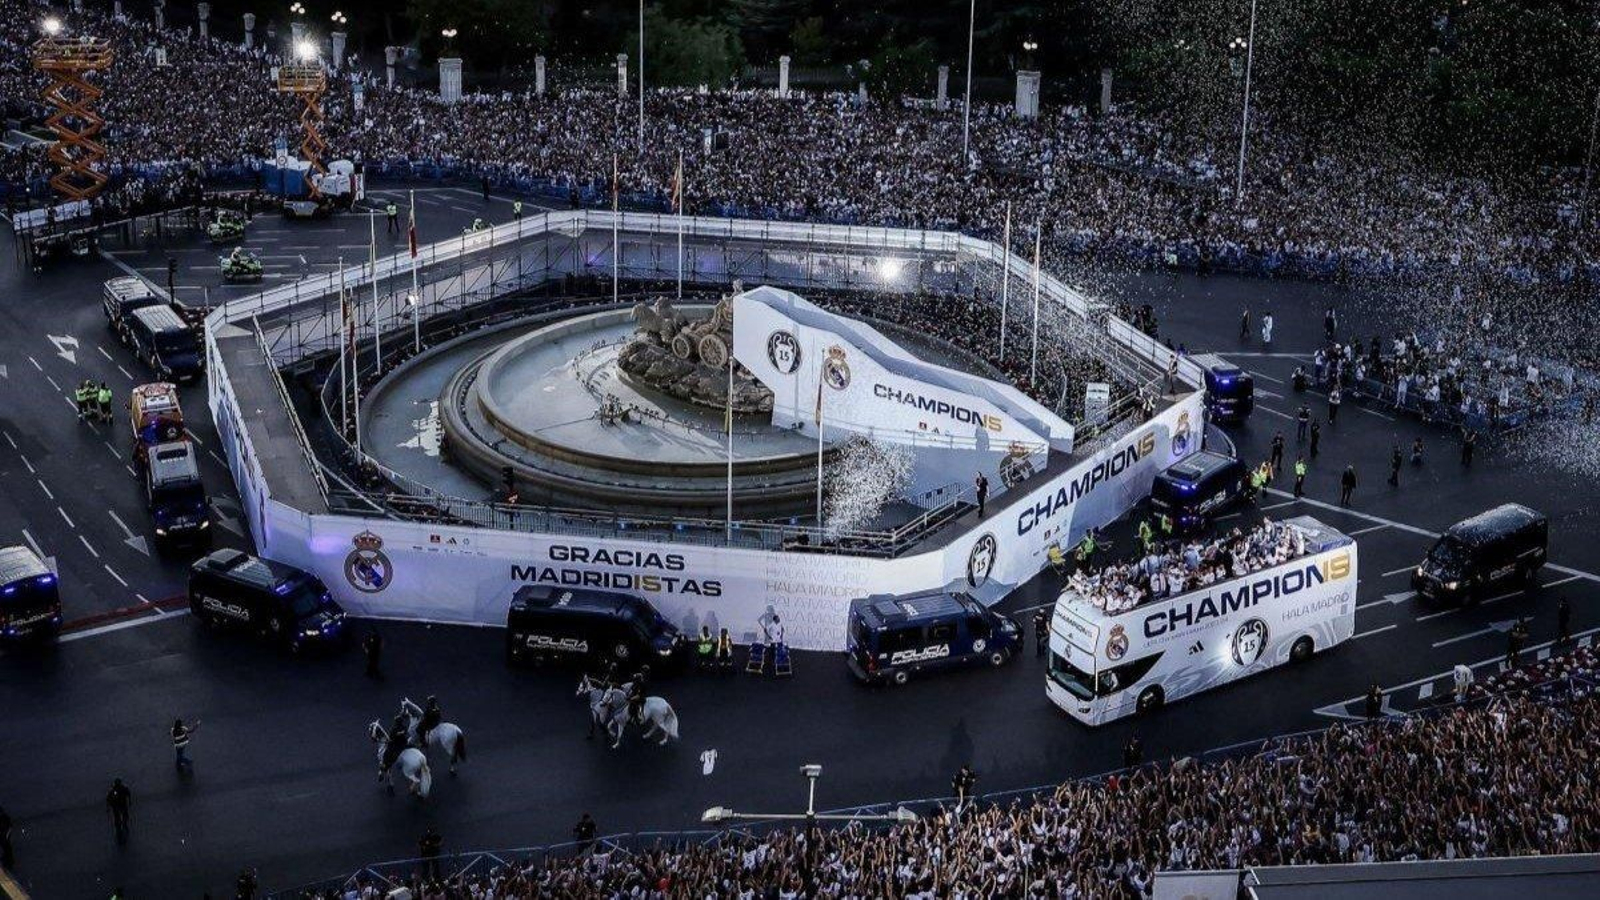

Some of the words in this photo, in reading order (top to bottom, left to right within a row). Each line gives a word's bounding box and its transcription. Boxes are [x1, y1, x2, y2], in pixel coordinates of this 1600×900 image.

[778, 349, 790, 362] 15
[549, 545, 685, 571] GRACIAS
[975, 558, 986, 575] 15
[1243, 639, 1256, 653] 15
